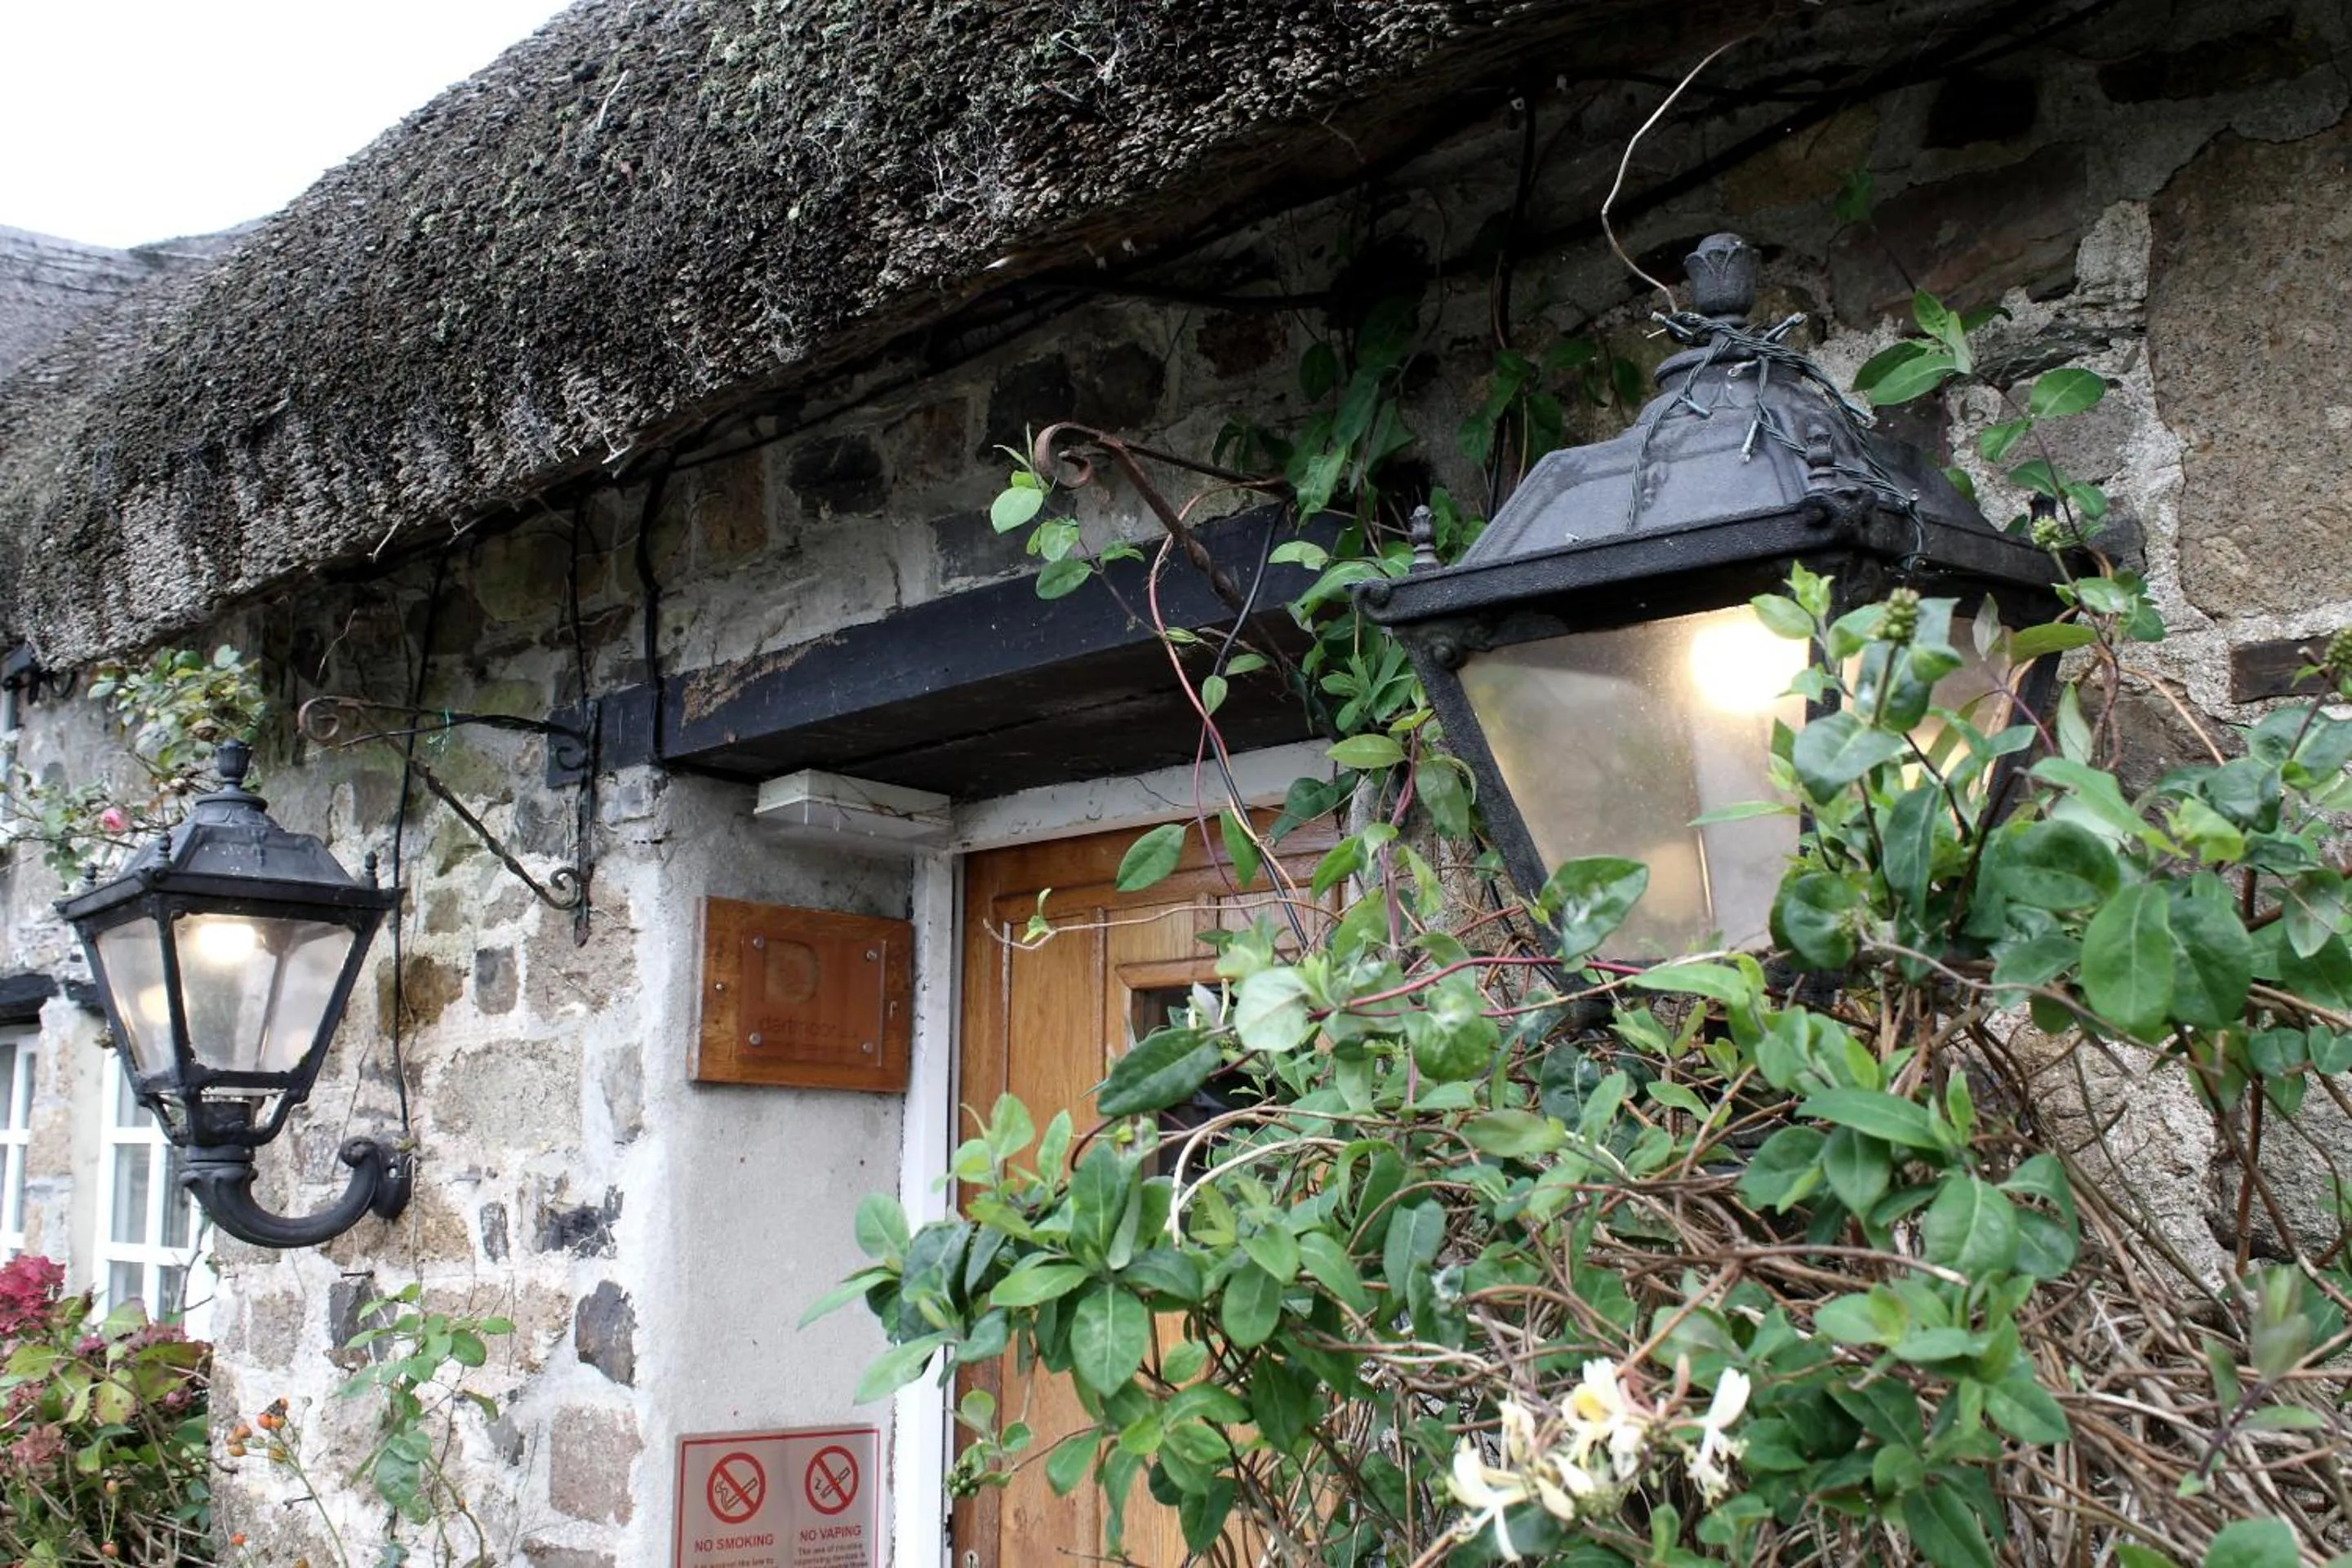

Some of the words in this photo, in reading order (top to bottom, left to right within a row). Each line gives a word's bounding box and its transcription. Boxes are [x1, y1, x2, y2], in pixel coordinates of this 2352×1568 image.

[800, 1530, 816, 1541] NO
[820, 1526, 862, 1539] VAPING
[695, 1539, 713, 1552] NO
[717, 1534, 774, 1550] SMOKING
